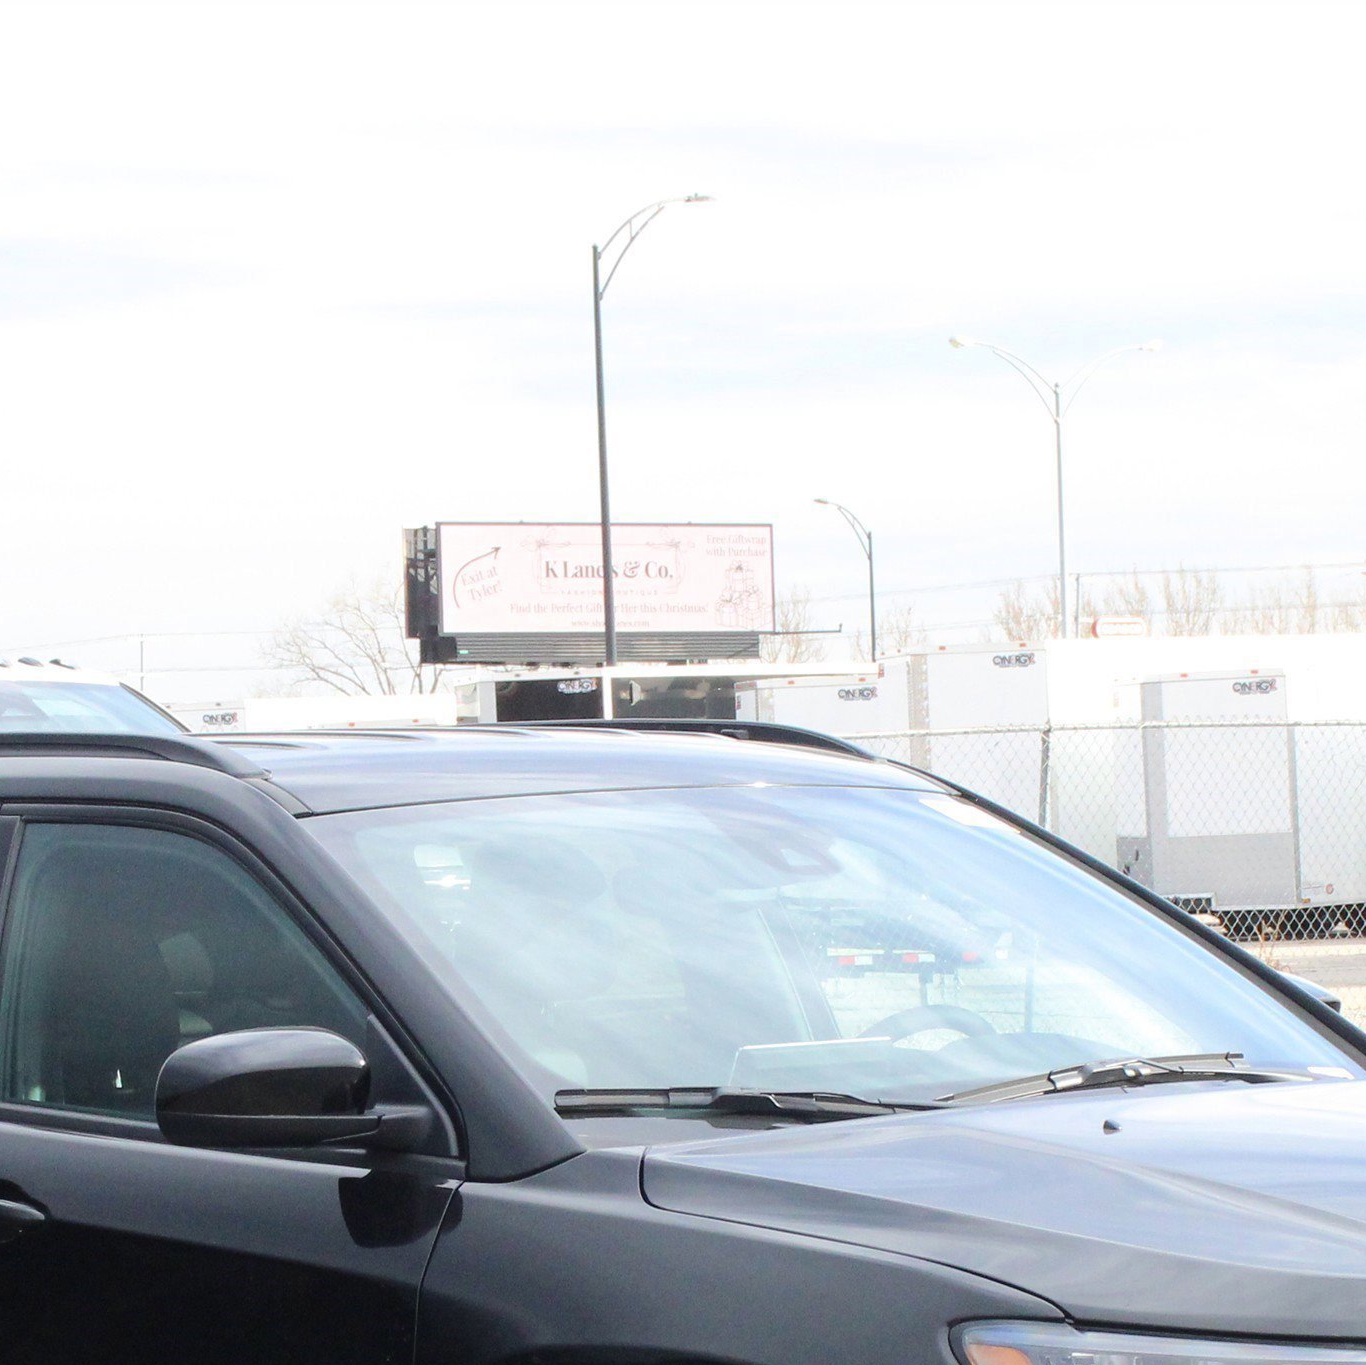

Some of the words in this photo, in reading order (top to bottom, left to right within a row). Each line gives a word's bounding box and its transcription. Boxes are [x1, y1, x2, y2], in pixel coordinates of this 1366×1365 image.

[706, 534, 726, 544] Free
[728, 534, 767, 546] Giftwrap
[706, 546, 725, 557] with
[728, 546, 768, 557] Purchase
[545, 560, 558, 578] K
[623, 560, 641, 579] &
[645, 560, 674, 579] Co.
[460, 568, 484, 588] Exit
[486, 565, 499, 579] at
[510, 603, 531, 613] Find
[533, 603, 548, 613] the
[551, 603, 583, 613] Perfect
[586, 603, 603, 613] Gift
[621, 603, 637, 613] Her
[640, 603, 656, 613] this
